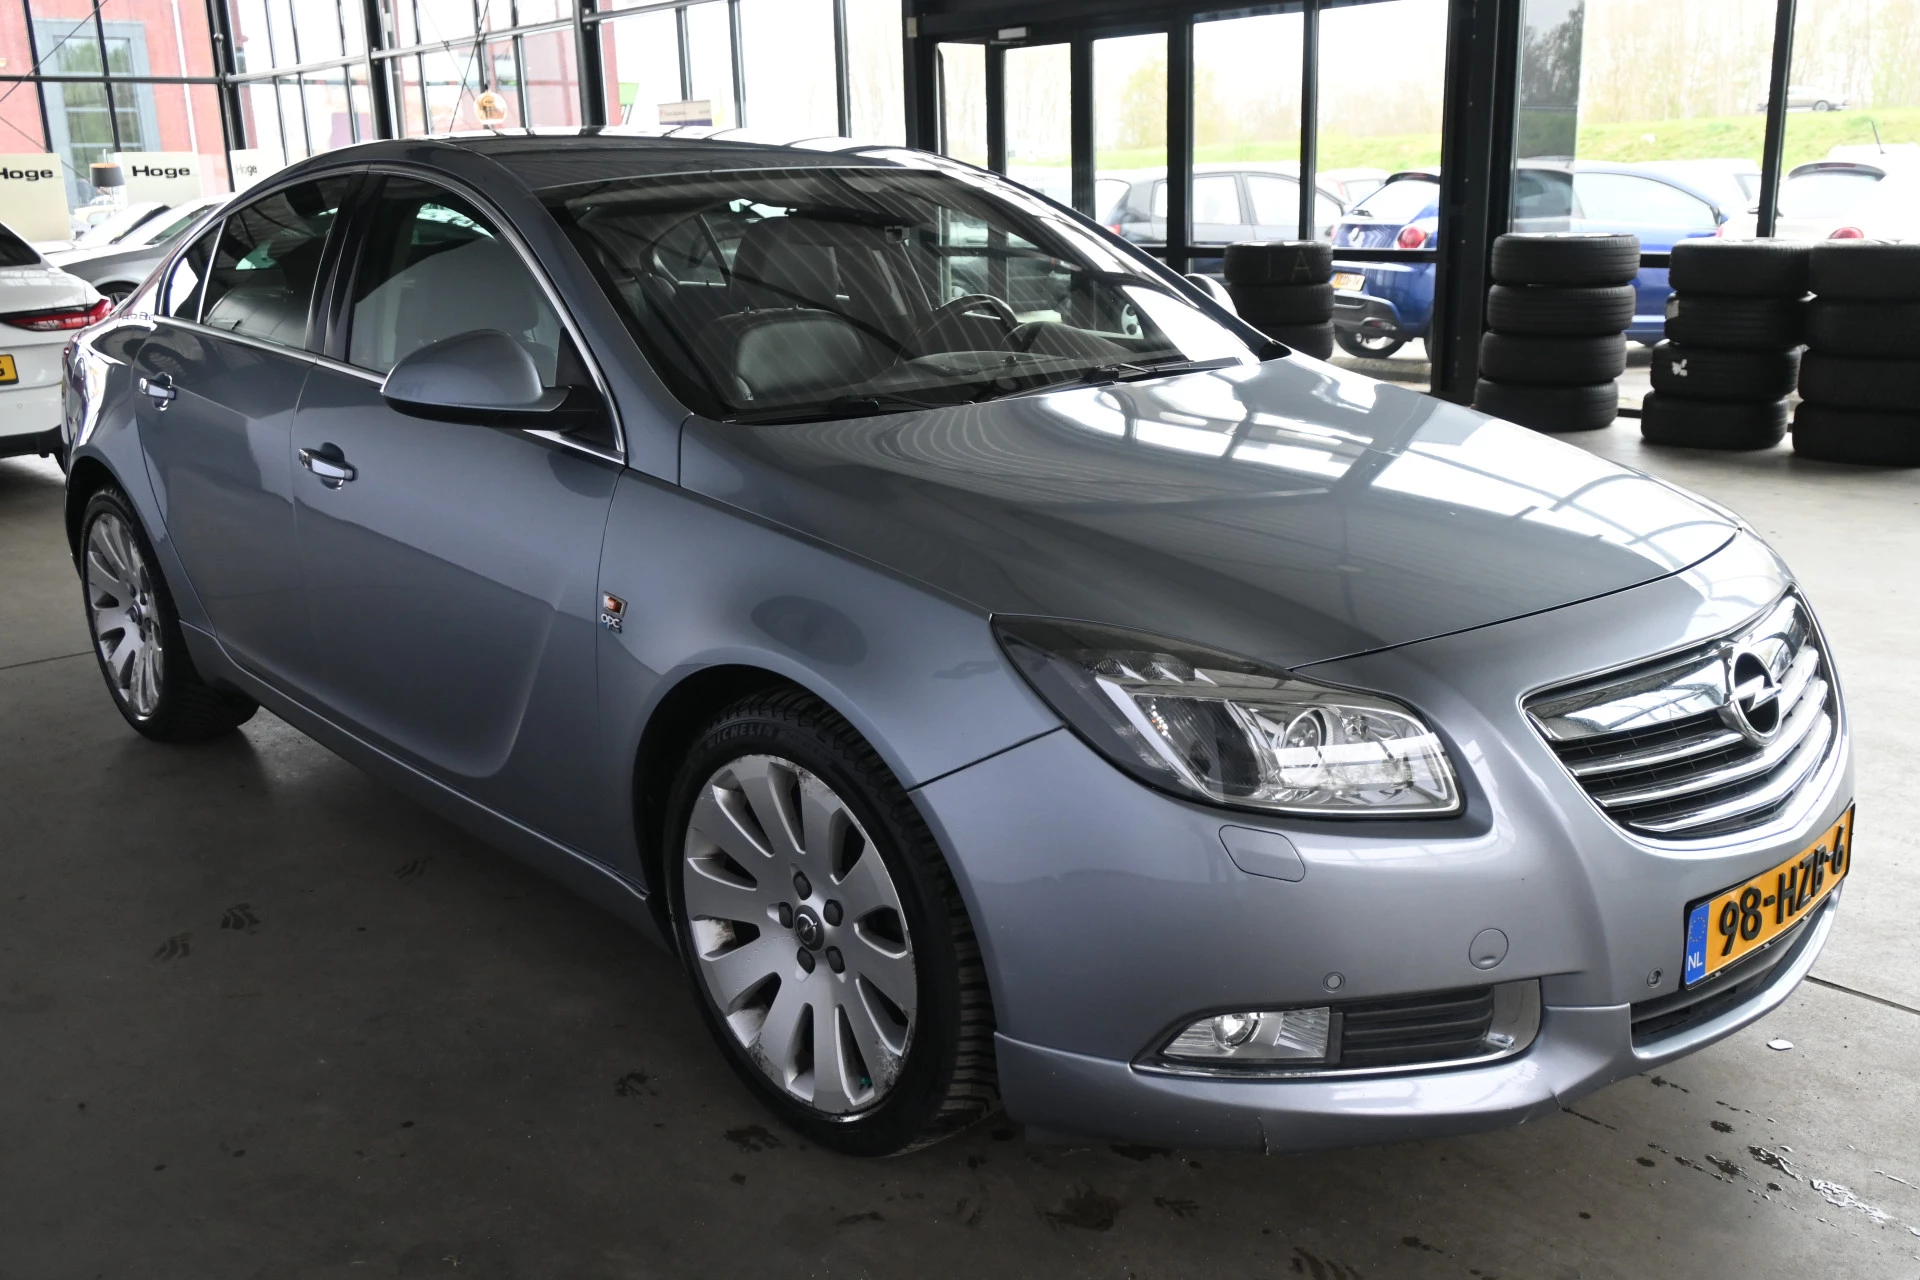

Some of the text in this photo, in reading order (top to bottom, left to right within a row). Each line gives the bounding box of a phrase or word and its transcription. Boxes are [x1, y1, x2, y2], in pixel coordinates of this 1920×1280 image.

[132, 165, 190, 178] Hoge
[1719, 823, 1845, 957] 98-HZB-6
[1688, 951, 1703, 971] NL
